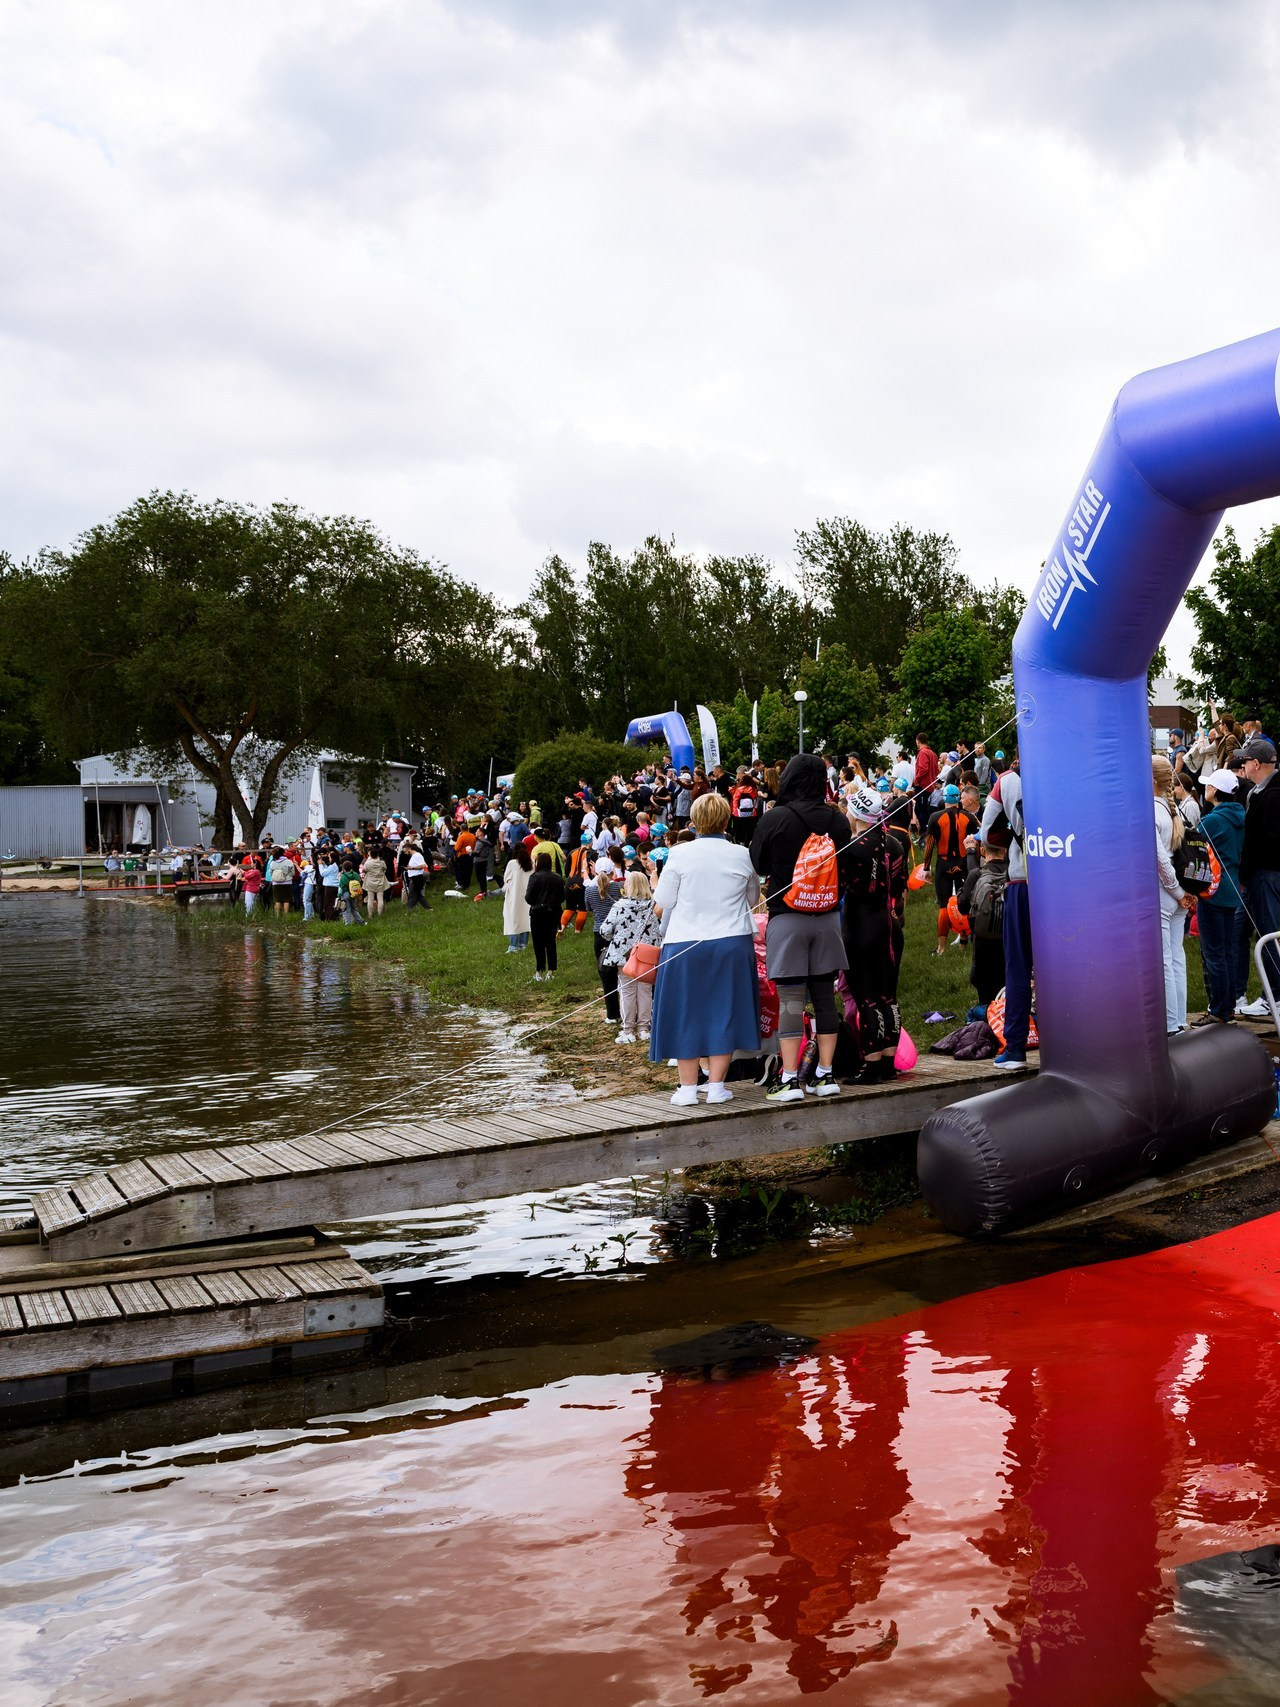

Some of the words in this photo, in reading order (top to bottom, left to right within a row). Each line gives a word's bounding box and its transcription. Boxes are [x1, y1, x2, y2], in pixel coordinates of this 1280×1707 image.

[1035, 556, 1069, 621] IRON
[1067, 479, 1104, 548] STAR
[1024, 826, 1076, 858] aier
[793, 899, 818, 908] MINSK
[798, 891, 834, 901] MANSTAR
